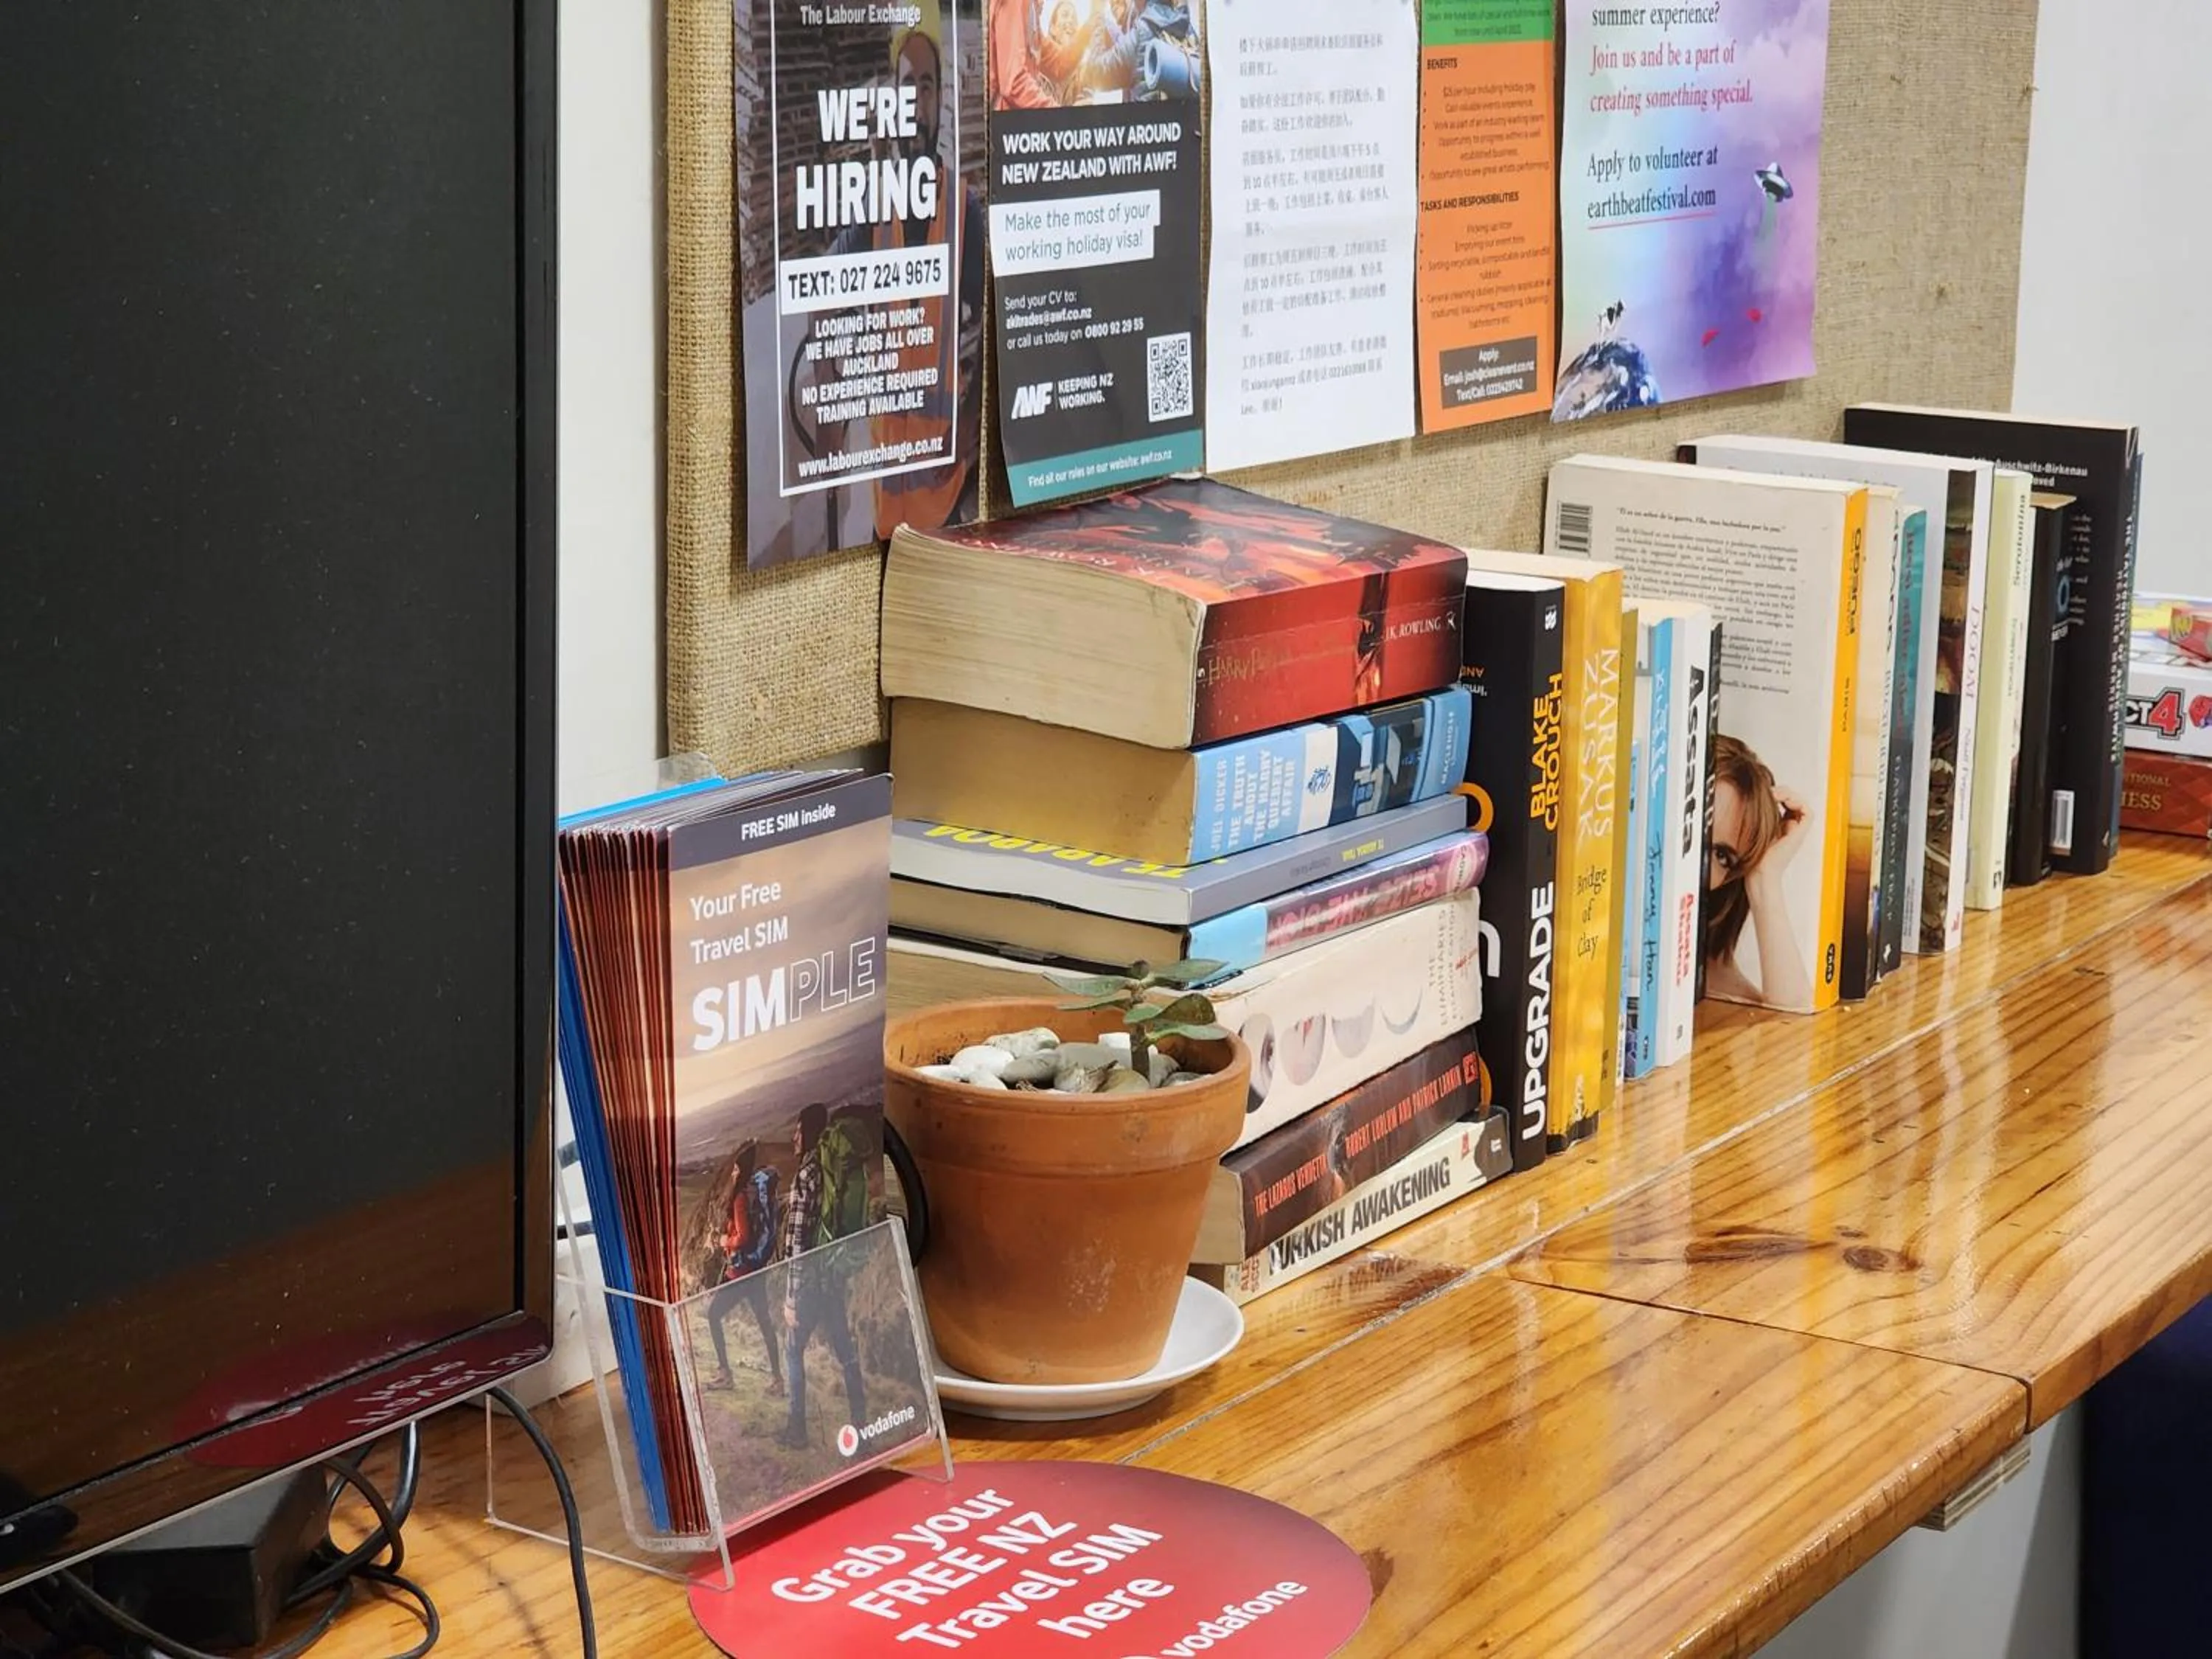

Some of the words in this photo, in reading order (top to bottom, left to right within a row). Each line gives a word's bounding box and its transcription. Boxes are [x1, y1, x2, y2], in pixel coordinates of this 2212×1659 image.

[801, 5, 823, 25] The
[826, 4, 865, 24] Labour
[869, 4, 921, 27] Exchange
[1592, 9, 1646, 26] summer
[1650, 1, 1720, 32] experience?
[1427, 58, 1458, 70] BENEFITS
[1590, 44, 1617, 75] Join
[1622, 52, 1636, 68] us
[1641, 42, 1663, 66] and
[1667, 43, 1681, 66] be
[1685, 50, 1691, 65] a
[1696, 46, 1719, 70] part
[1723, 40, 1736, 63] of
[818, 86, 917, 142] WE'RE
[1590, 86, 1641, 116] creating
[1646, 83, 1708, 111] something
[1711, 79, 1753, 111] special.
[1003, 131, 1051, 154] WORK
[1054, 128, 1091, 151] YOUR
[1094, 126, 1125, 147] WAY
[1127, 122, 1181, 145] AROUND
[1002, 163, 1039, 185] NEW
[1042, 157, 1106, 182] ZEALAND
[1108, 153, 1141, 175] WITH
[1144, 150, 1178, 172] AWF!
[1587, 150, 1624, 183] Apply
[1629, 152, 1641, 172] to
[1646, 146, 1703, 171] volunteer
[1706, 146, 1718, 165] at
[796, 156, 937, 230] HIRING
[1421, 198, 1442, 213] TASKS
[1444, 196, 1457, 209] AND
[1458, 191, 1519, 207] RESPONSIBILITIES
[1587, 185, 1717, 219] earthbeatfestival.com
[1005, 209, 1042, 232] Make
[1047, 209, 1070, 228] the
[1074, 206, 1105, 226] most
[1108, 203, 1121, 222] of
[1124, 203, 1150, 223] your
[1005, 237, 1061, 261] working
[1067, 233, 1113, 254] holiday
[1116, 230, 1143, 249] visa!
[789, 271, 835, 300] TEXT:
[841, 267, 867, 292] 027
[874, 263, 900, 289] 224
[905, 258, 941, 285] 9675
[1005, 296, 1025, 310] Send
[1027, 293, 1047, 310] your
[1048, 291, 1062, 306] CV
[1064, 291, 1077, 303] to:
[815, 315, 863, 338] LOOKING
[866, 312, 886, 331] FOR
[889, 307, 925, 327] WORK?
[1006, 337, 1018, 350] or
[1018, 335, 1032, 349] call
[1033, 333, 1043, 346] us
[1045, 328, 1068, 346] today
[1071, 329, 1082, 341] on
[1085, 322, 1108, 339] 0800
[806, 341, 824, 361] WE
[825, 337, 853, 358] HAVE
[855, 333, 883, 354] JOBS
[885, 330, 904, 349] ALL
[907, 327, 933, 347] OVER
[842, 352, 899, 378] AUCKLAND
[1058, 375, 1097, 394] KEEPING
[1099, 372, 1114, 388] NZ
[801, 386, 818, 405] NO
[820, 375, 884, 403] EXPERIENCE
[886, 368, 939, 392] REQUIRED
[1011, 382, 1053, 420] AWF
[1058, 390, 1106, 410] WORKING.
[816, 399, 866, 424] TRAINING
[869, 391, 925, 416] AVAILABLE
[799, 436, 943, 477] www.labourexchange.co.nz
[2033, 476, 2055, 487] oved
[1848, 527, 1863, 636] FUEGO
[1399, 615, 1441, 640] ROWLING
[1964, 606, 1980, 699] DOOM
[1531, 694, 1549, 818] BLAKE
[1544, 673, 1564, 832] CROUCH
[1578, 653, 1599, 839] ZUSAK
[1594, 648, 1620, 837] MARKUS
[1258, 748, 1272, 804] HARRY
[1682, 666, 1705, 860] Assata
[1214, 758, 1228, 813] DICKER
[1231, 754, 1246, 811] TRUTH
[1243, 771, 1259, 827] ABOUT
[1281, 759, 1296, 817] AFFAIR
[2121, 790, 2162, 811] ESS
[741, 817, 775, 841] FREE
[776, 810, 800, 833] SIM
[801, 803, 836, 826] inside
[1210, 819, 1224, 853] JOEL
[1227, 815, 1242, 850] THE
[1253, 809, 1268, 844] THE
[1577, 867, 1607, 895] Bridge
[690, 893, 736, 921] Your
[740, 882, 782, 910] Free
[1582, 899, 1593, 925] of
[690, 932, 751, 964] Travel
[755, 916, 788, 949] SIM
[1577, 931, 1599, 959] Clay
[692, 936, 876, 1051] SIMPLE
[1522, 883, 1554, 1141] UPGRADE
[1345, 1123, 1371, 1158] ROBERT
[1371, 1107, 1399, 1142] LUDLUM
[1398, 1096, 1413, 1124] AND
[1412, 1080, 1438, 1114] PATRICK
[1438, 1065, 1462, 1097] LARKIN
[1254, 1193, 1268, 1218] THE
[1267, 1177, 1296, 1209] LAZARUS
[1295, 1154, 1327, 1189] VENDETTA
[1268, 1208, 1346, 1275] TURKISH
[1350, 1157, 1451, 1236] AWAKENING
[860, 1404, 916, 1440] vodafone
[771, 1540, 907, 1604] Grab
[893, 1487, 1016, 1551] your
[849, 1545, 1006, 1621] FREE
[980, 1509, 1079, 1557] NZ
[896, 1569, 1079, 1650] Travel
[1059, 1522, 1166, 1576] SIM
[1037, 1573, 1175, 1641] here
[1161, 1578, 1310, 1659] vodafone
